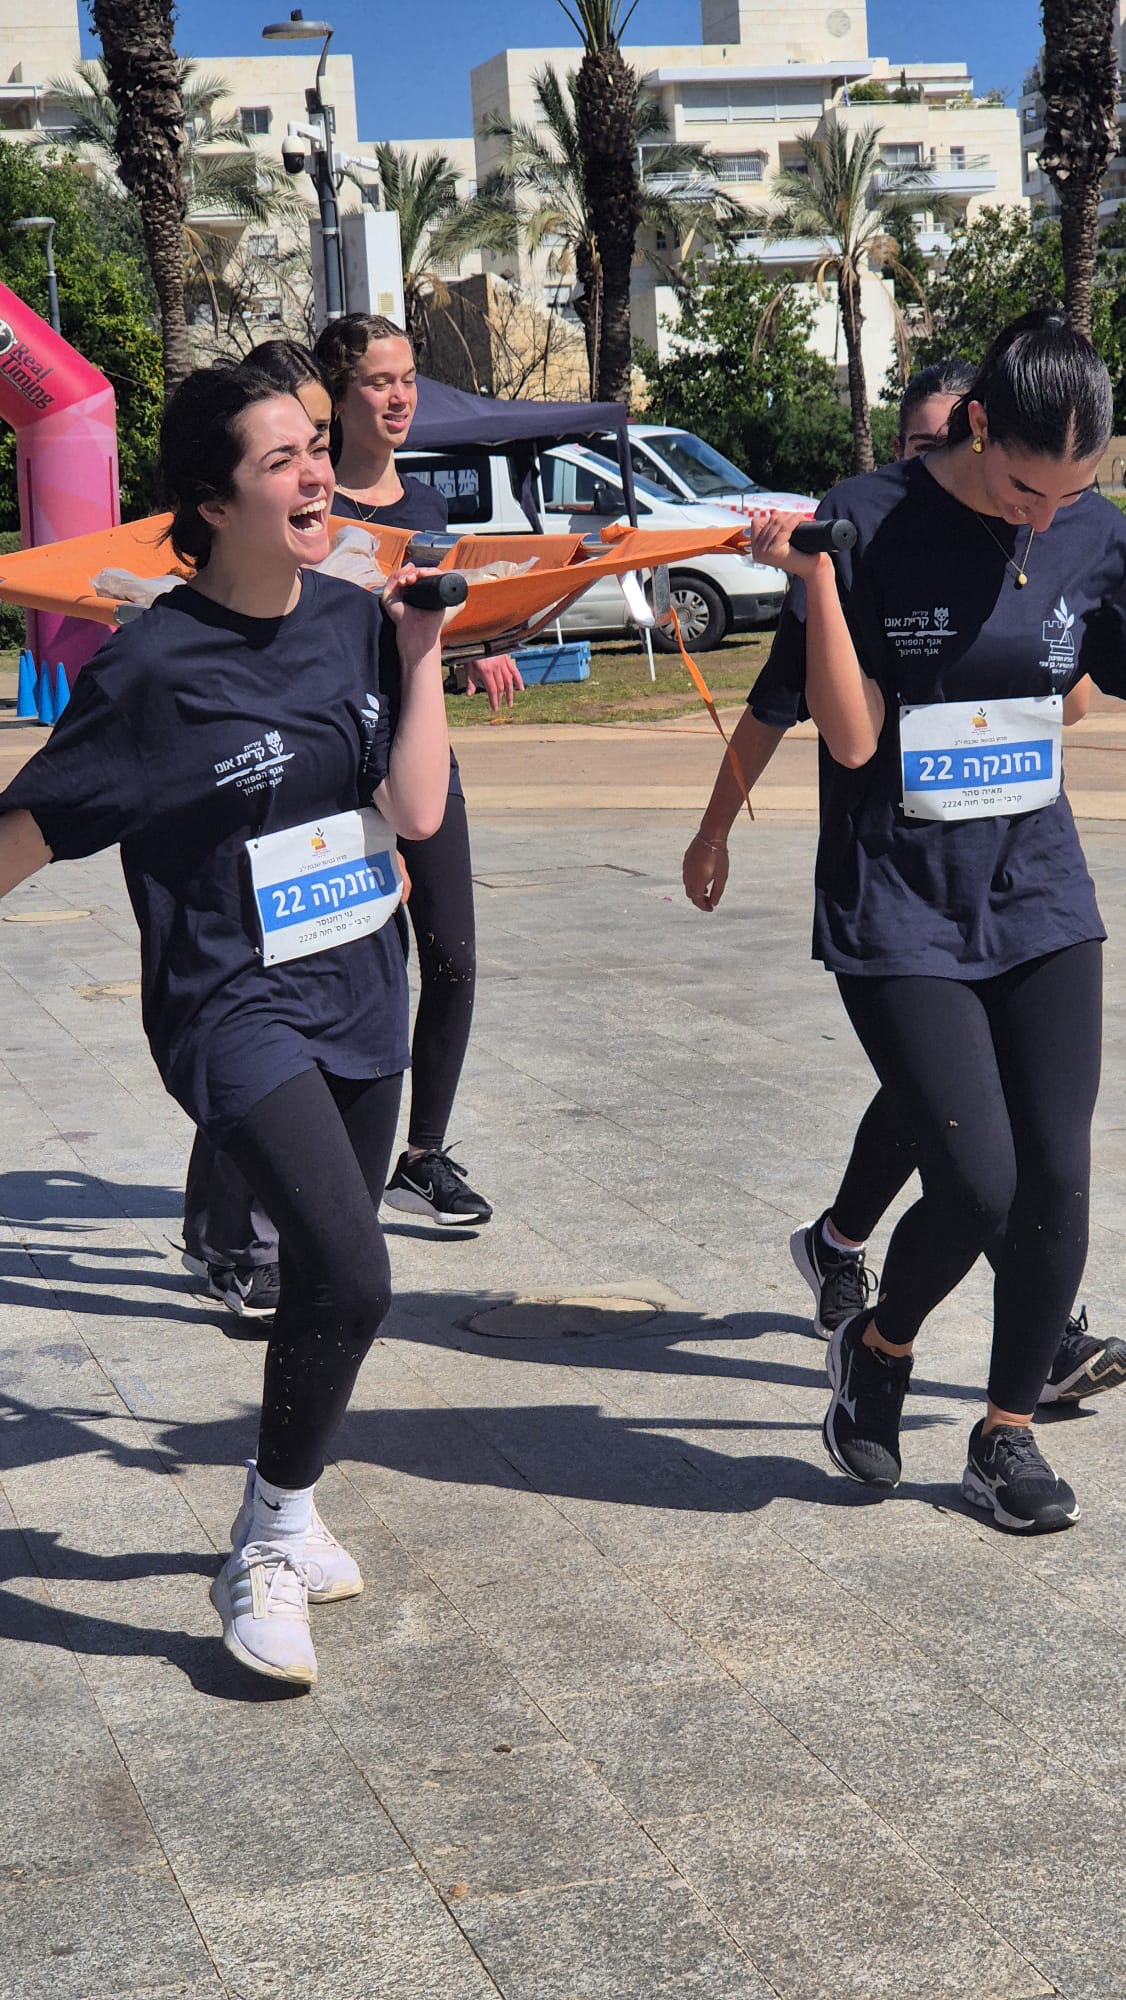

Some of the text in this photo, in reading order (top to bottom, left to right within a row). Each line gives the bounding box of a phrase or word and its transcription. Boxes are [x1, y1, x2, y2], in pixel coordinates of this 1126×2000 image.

[13, 343, 54, 379] Real
[1, 353, 55, 409] Timing
[884, 616, 930, 630] קריית אונו
[895, 638, 942, 647] אגף הספורט
[899, 648, 939, 657] אגף החינוך
[214, 747, 265, 774] קריית אונו
[919, 751, 1041, 783] הזנקה 22
[236, 765, 285, 788] אגף הספורט
[982, 787, 1003, 795] מאיה
[942, 800, 962, 809] 2224
[1003, 795, 1023, 803] קרבי
[271, 866, 385, 919] הזנקה 22
[344, 910, 353, 919] נוי
[354, 915, 371, 925] קרבי
